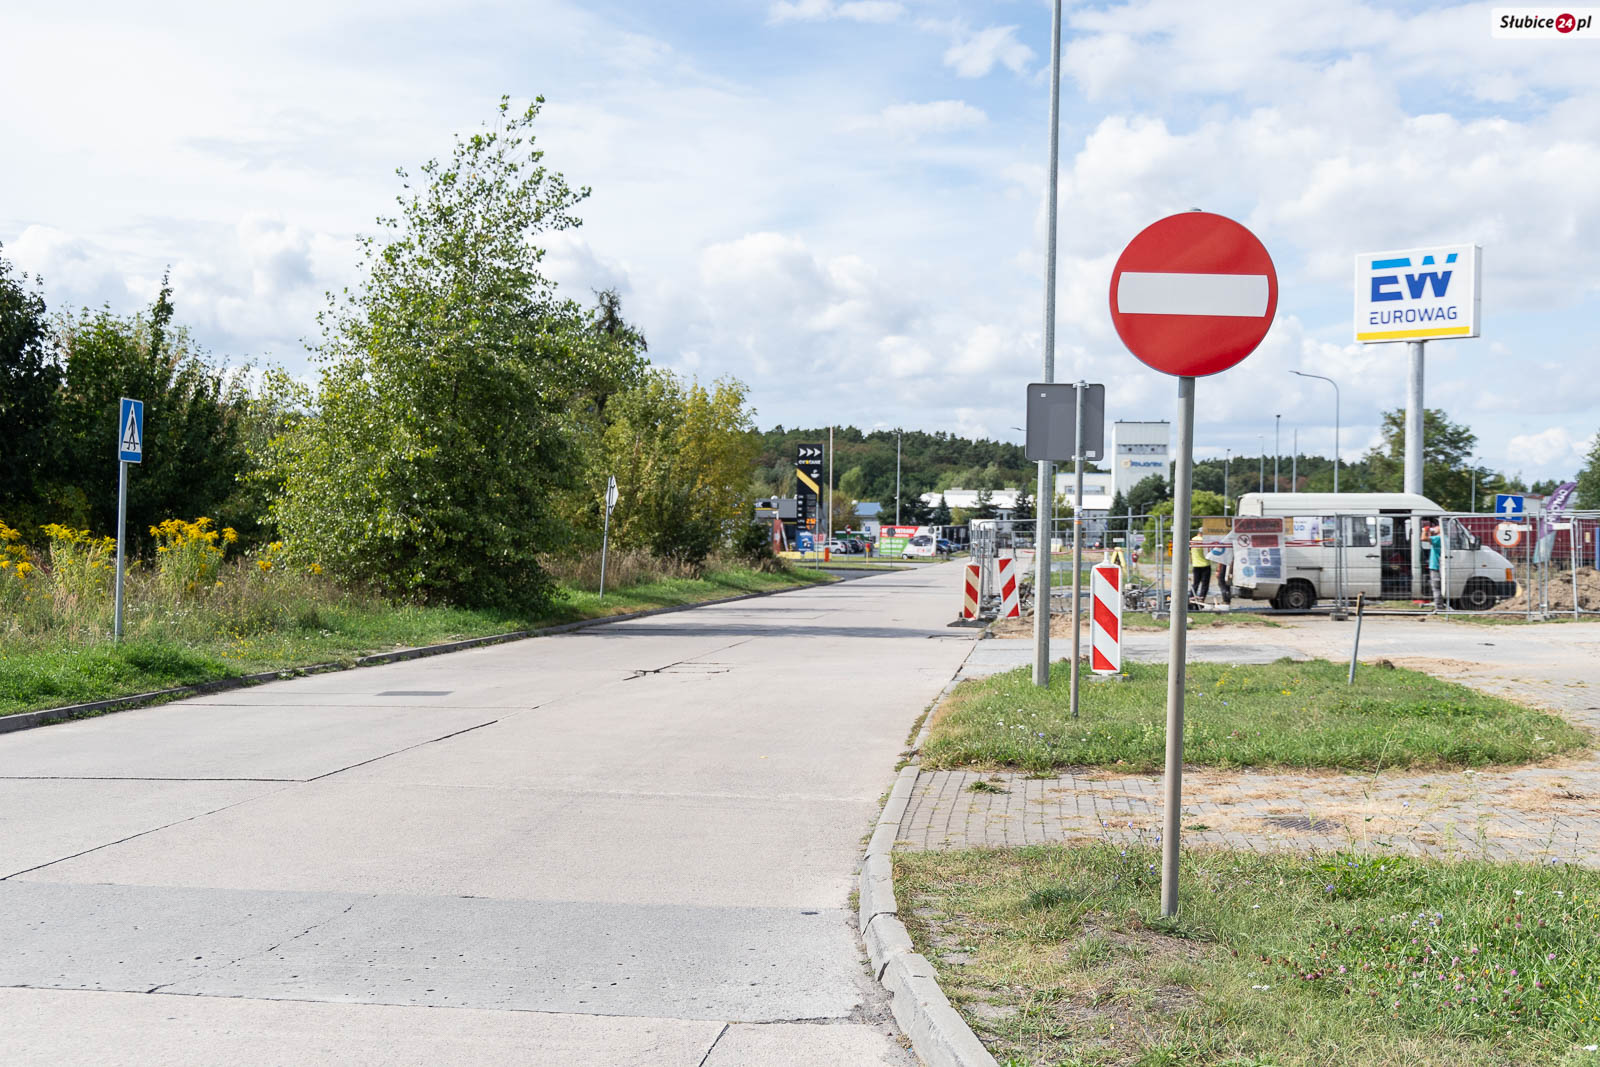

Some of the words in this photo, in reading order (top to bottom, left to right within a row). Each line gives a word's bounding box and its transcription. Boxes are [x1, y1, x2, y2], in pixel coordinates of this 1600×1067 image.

[1370, 253, 1458, 302] EW
[1369, 306, 1458, 325] EUROWAG
[1503, 529, 1512, 541] 5
